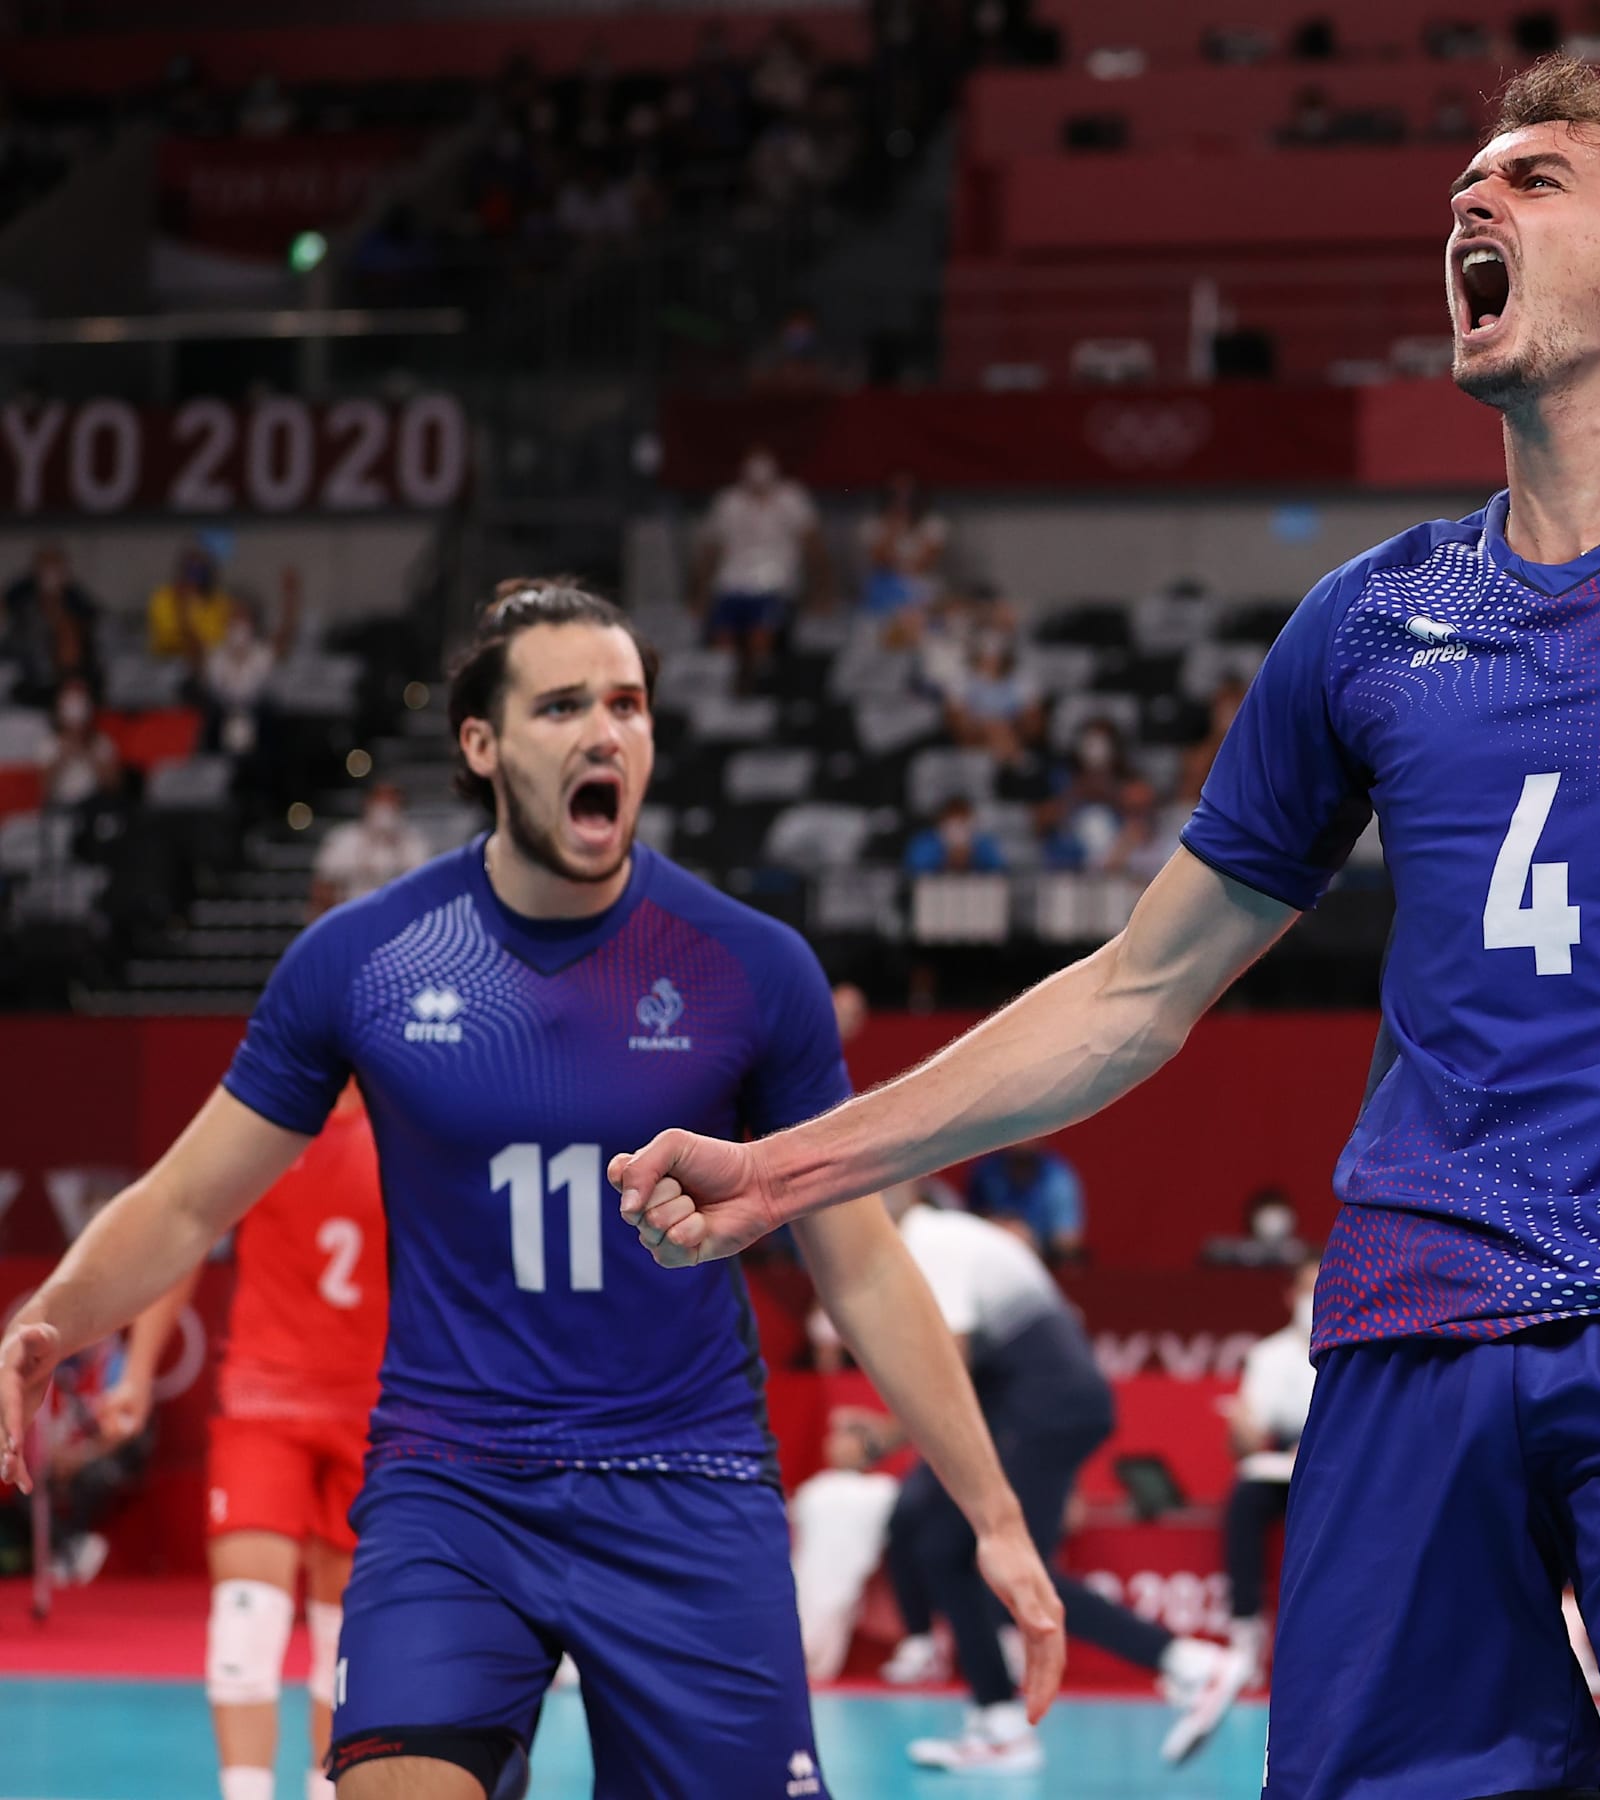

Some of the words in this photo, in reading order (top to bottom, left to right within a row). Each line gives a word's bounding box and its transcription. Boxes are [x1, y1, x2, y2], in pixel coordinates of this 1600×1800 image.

[172, 396, 466, 510] 2020
[1410, 643, 1468, 668] errea
[1483, 772, 1581, 976] 4
[404, 1021, 462, 1043] errea
[628, 1036, 691, 1050] FRANCE
[316, 1217, 362, 1310] 2
[489, 1143, 604, 1293] 11
